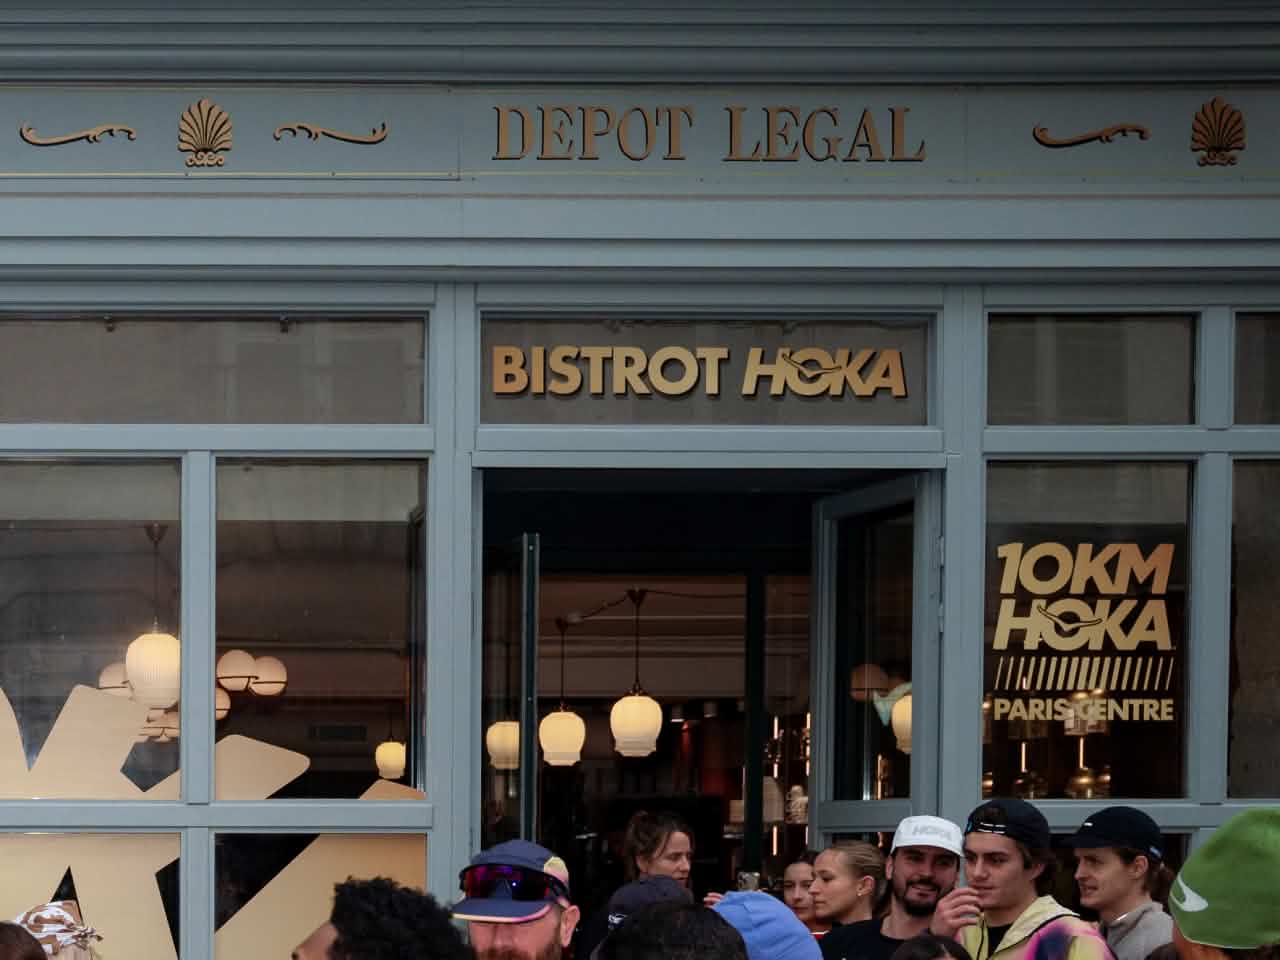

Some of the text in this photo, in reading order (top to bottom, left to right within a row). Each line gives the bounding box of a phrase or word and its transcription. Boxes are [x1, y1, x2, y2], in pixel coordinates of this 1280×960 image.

[491, 104, 927, 162] DEPOT LEGAL
[491, 345, 909, 398] BISTROT HOKA
[997, 541, 1176, 595] 10KM
[992, 597, 1174, 652] HOKA
[993, 698, 1174, 721] PARIS CENTRE
